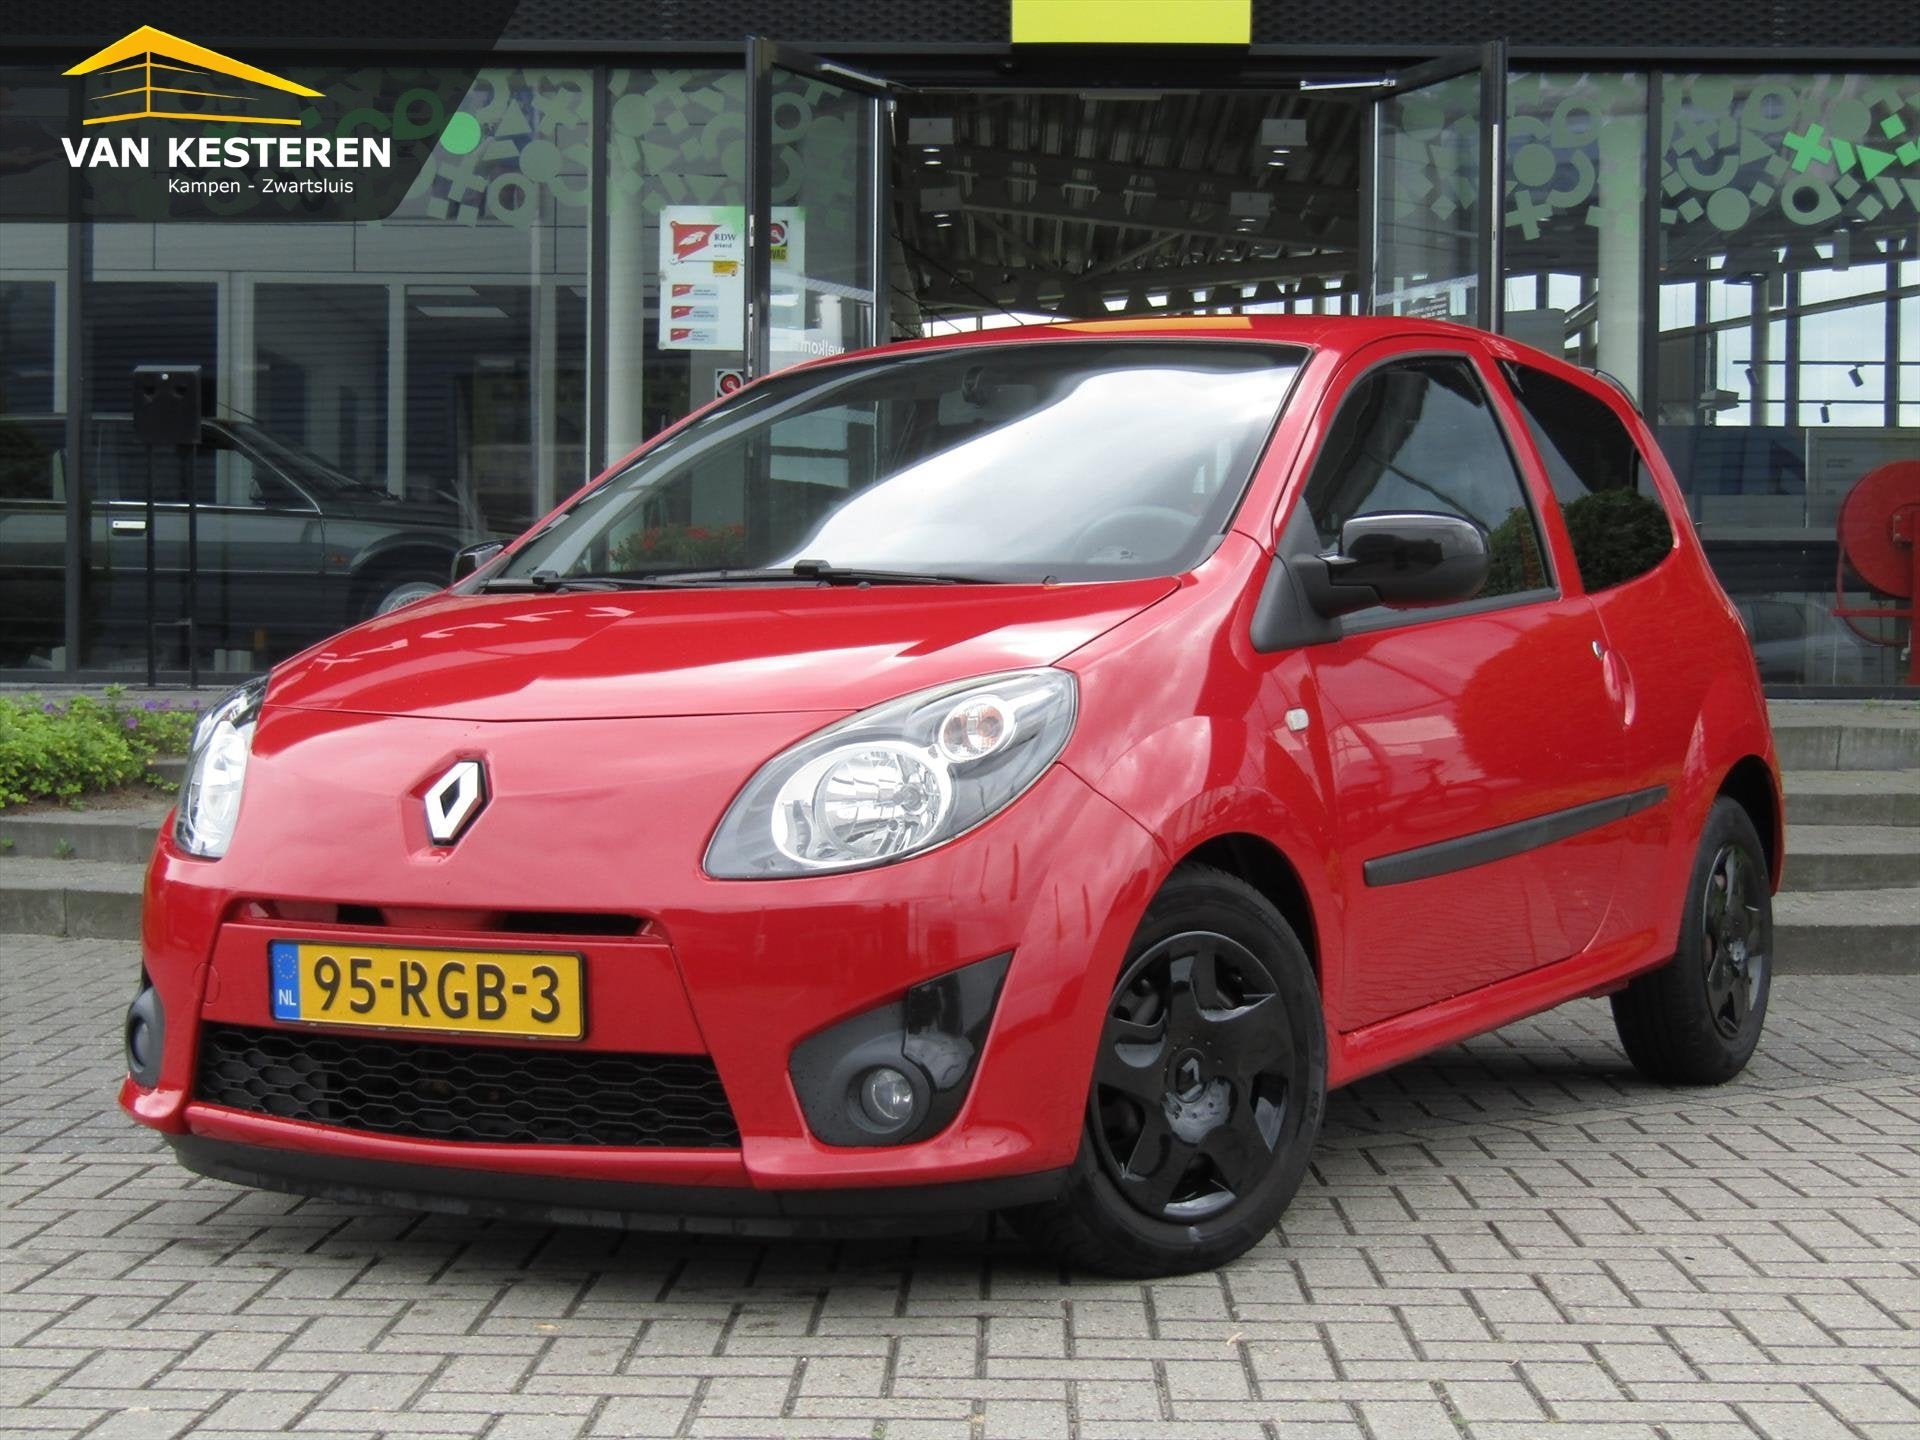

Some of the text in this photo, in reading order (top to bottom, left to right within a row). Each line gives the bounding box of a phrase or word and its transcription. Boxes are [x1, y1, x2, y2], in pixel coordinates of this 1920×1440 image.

[714, 233, 737, 241] RDW
[769, 248, 787, 260] VAG
[313, 955, 561, 1023] 95-RGB-3
[278, 989, 297, 1007] NL
